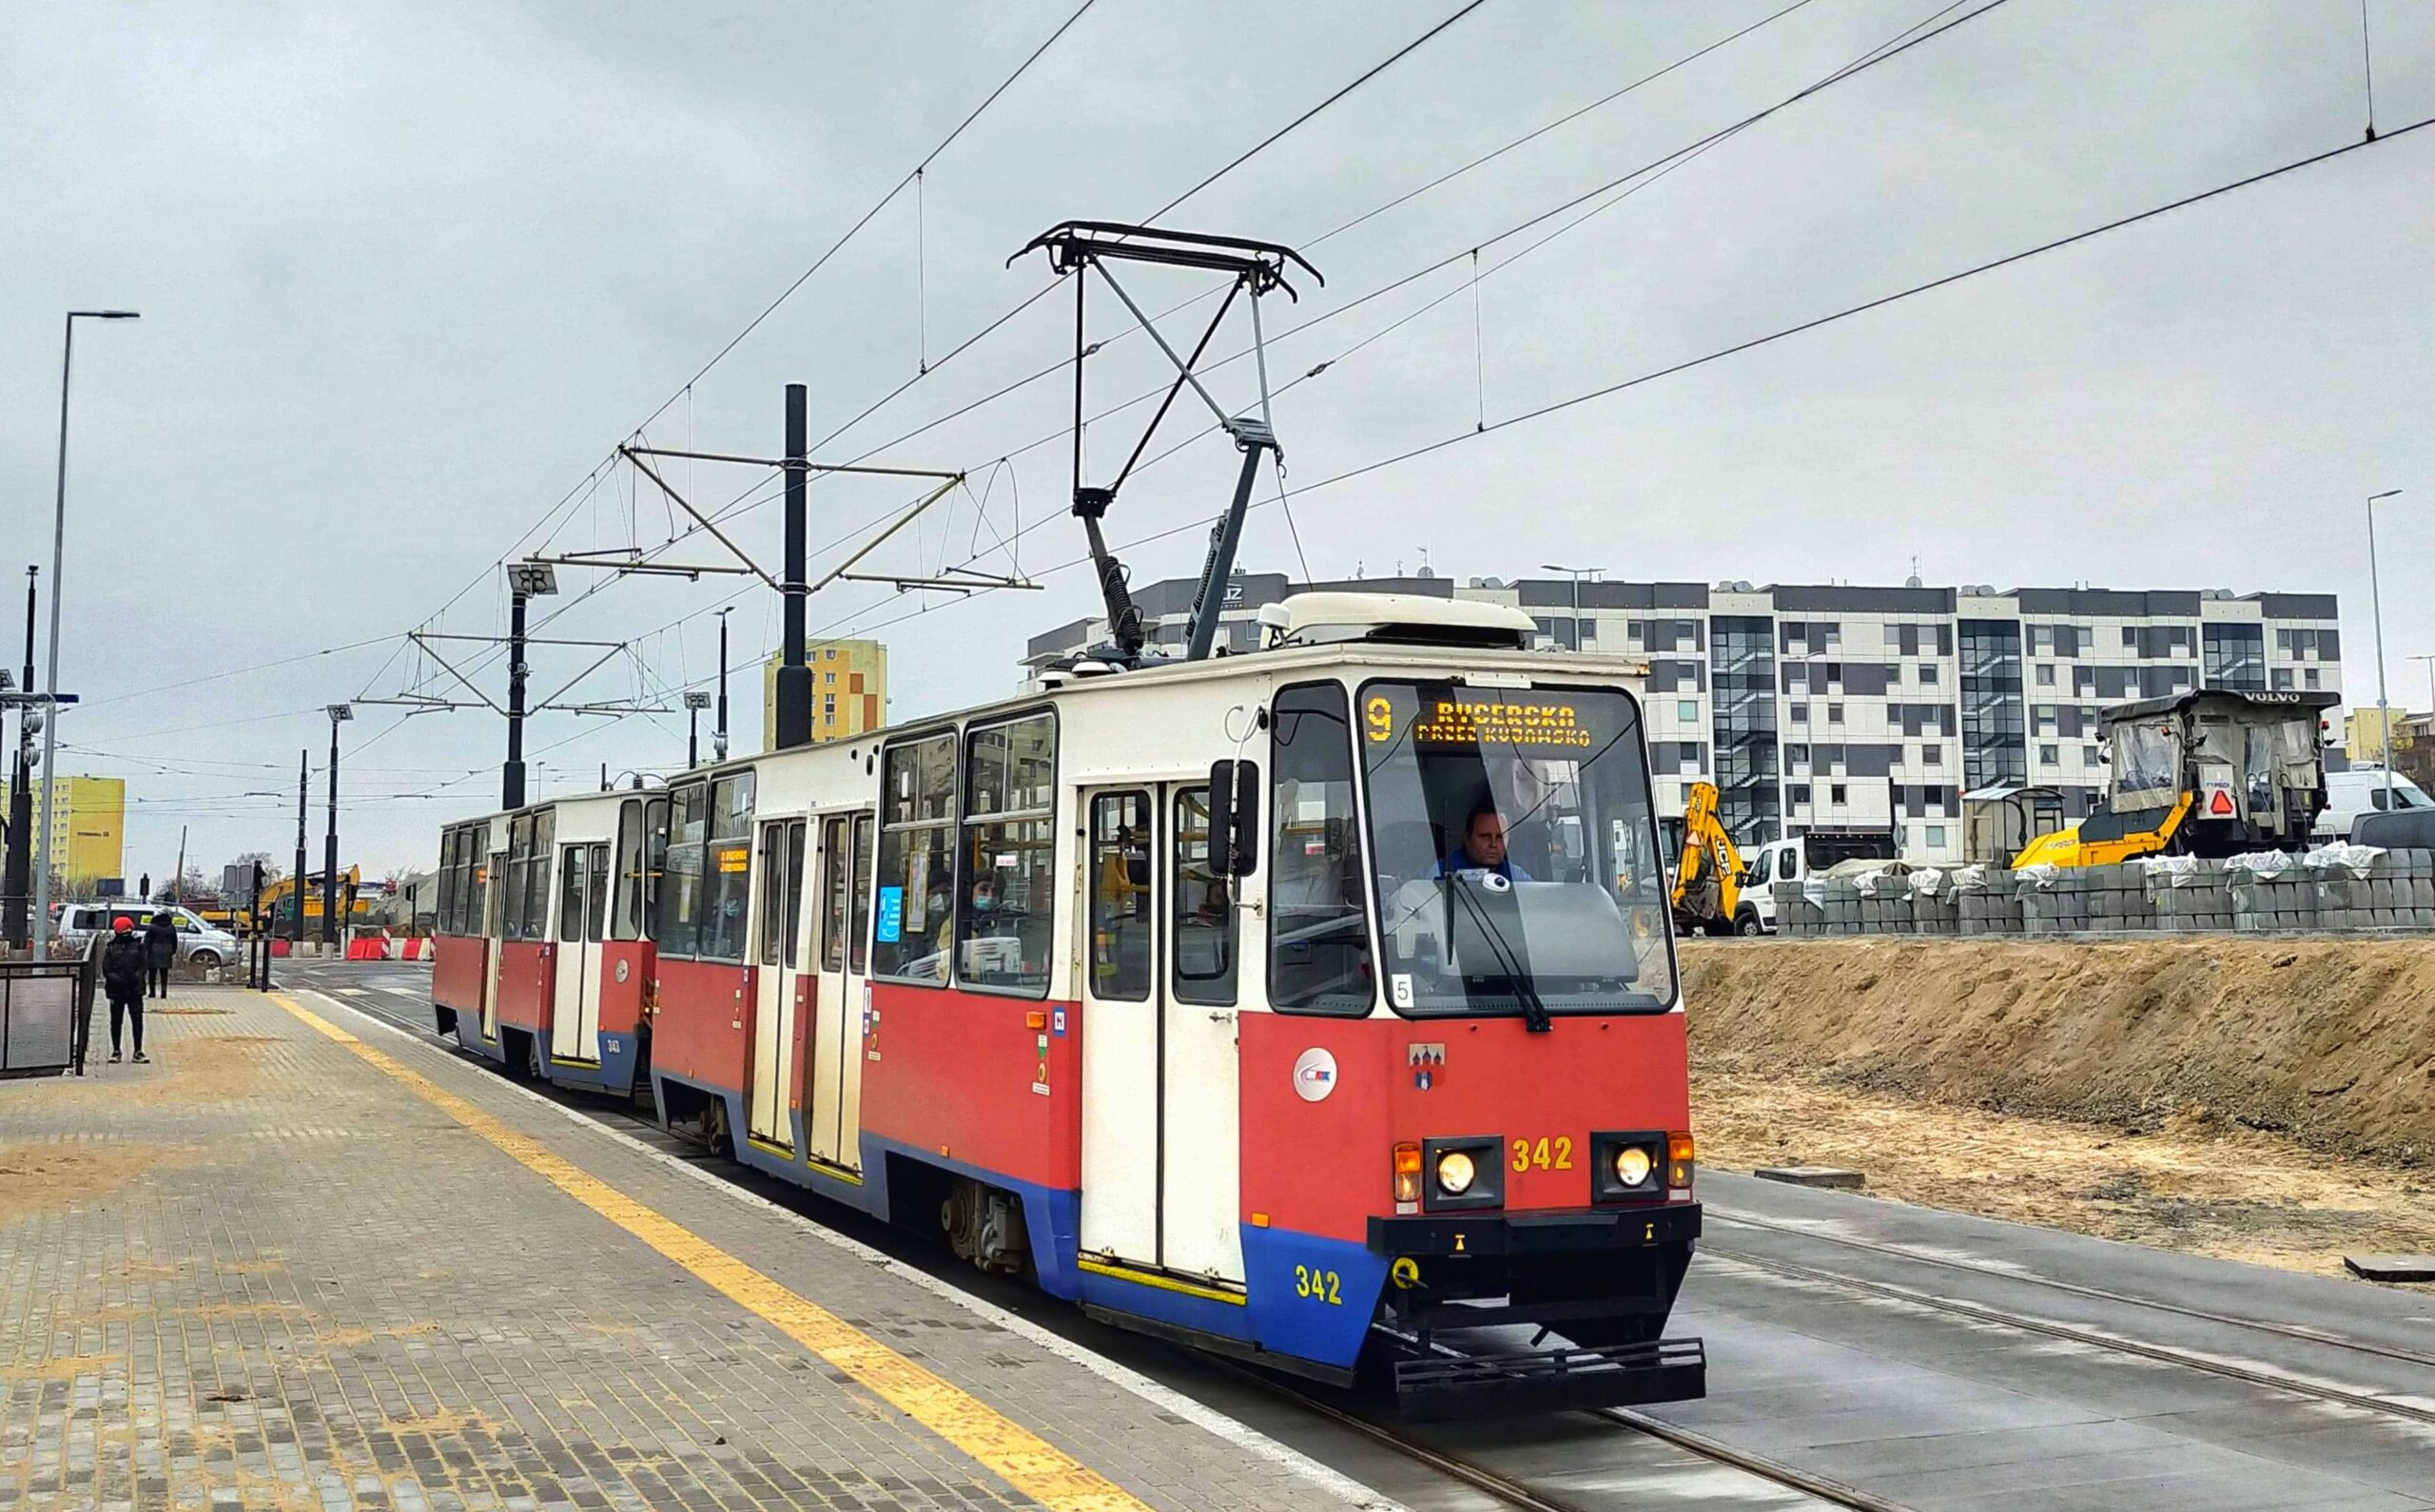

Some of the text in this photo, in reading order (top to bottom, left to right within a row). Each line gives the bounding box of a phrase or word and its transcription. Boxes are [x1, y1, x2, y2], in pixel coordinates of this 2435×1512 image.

[2244, 692, 2300, 703] VOLVO
[1368, 697, 1392, 741] 9
[1437, 702, 1575, 727] RYCERSKA
[1397, 981, 1409, 1000] 5
[1511, 1135, 1573, 1173] 342
[1295, 1264, 1343, 1306] 342
